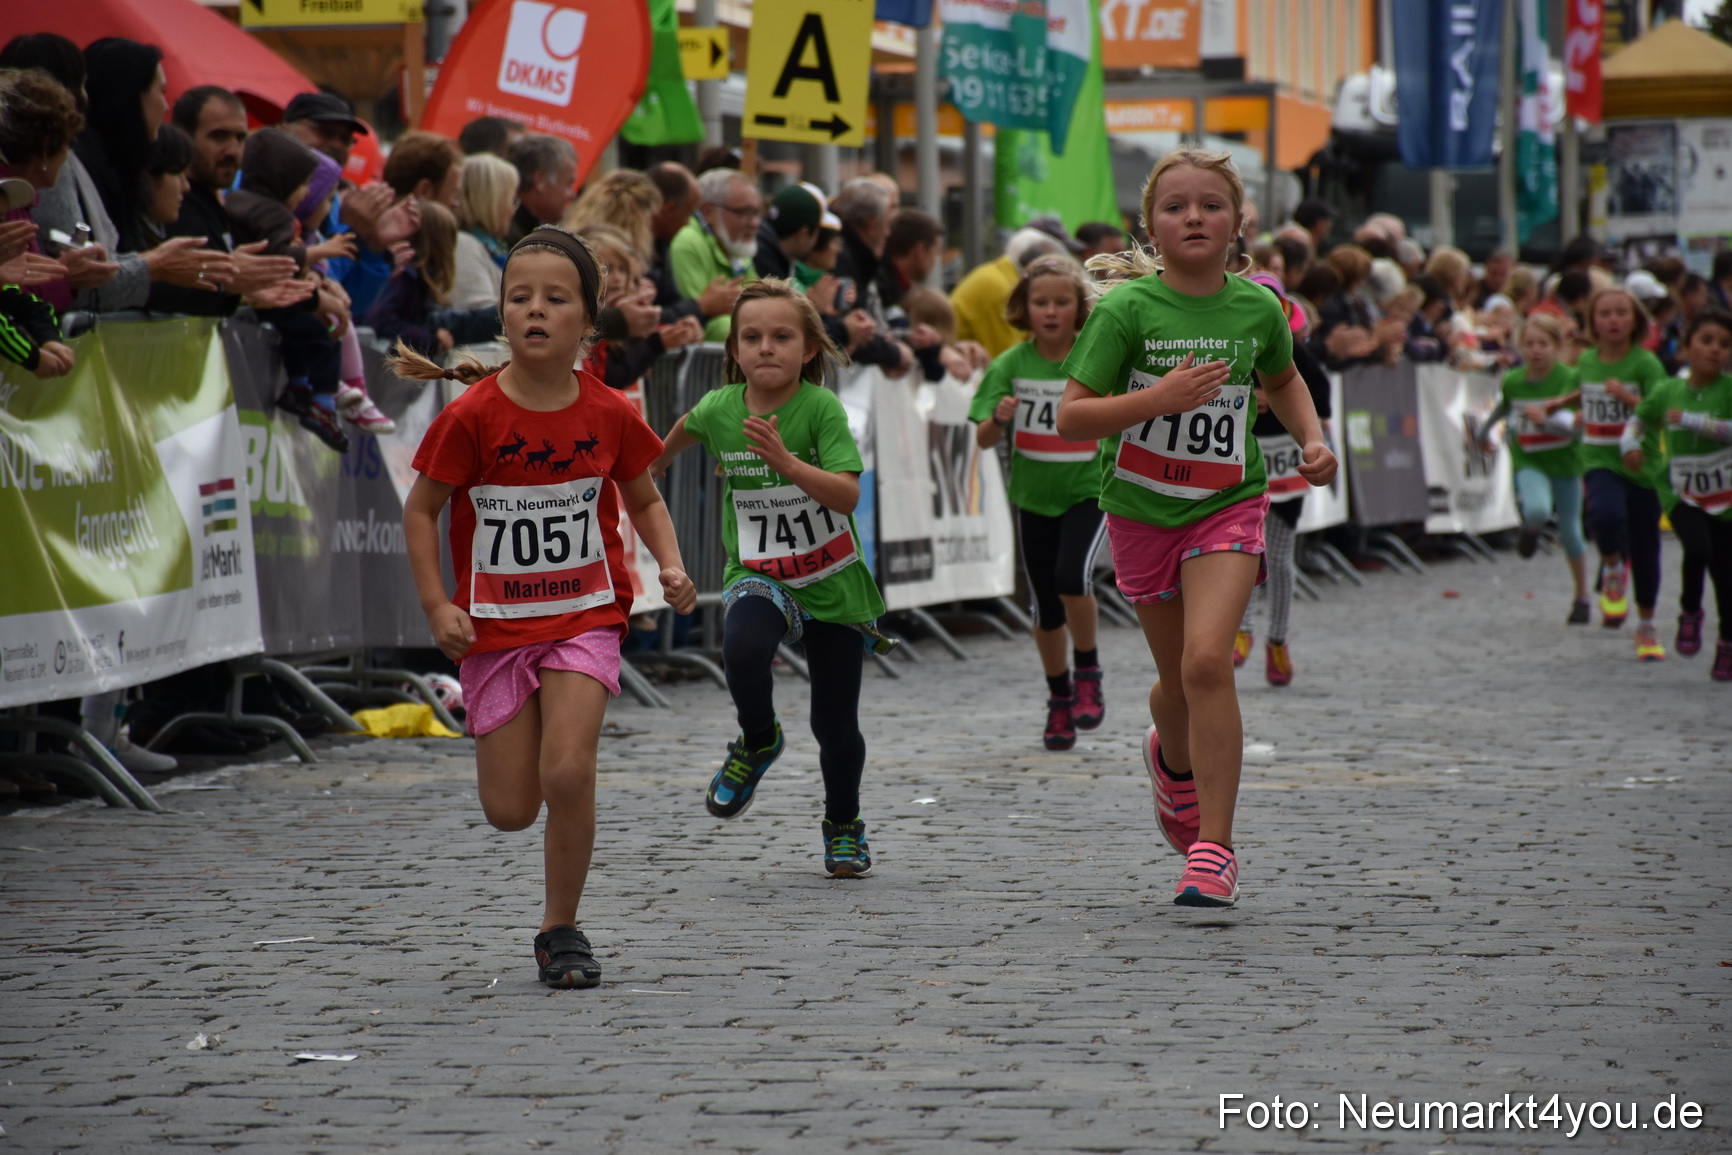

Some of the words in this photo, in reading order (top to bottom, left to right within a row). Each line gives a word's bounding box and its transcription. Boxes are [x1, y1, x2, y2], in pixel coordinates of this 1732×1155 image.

[772, 13, 841, 104] A
[505, 58, 568, 96] DKMS
[1144, 336, 1230, 352] Neumarkter
[1162, 463, 1192, 483] Lili
[476, 497, 514, 512] PARTL
[516, 493, 581, 512] Neumarkt
[736, 500, 769, 511] PARTL
[483, 508, 590, 567] 7057
[748, 505, 836, 554] 7411
[503, 578, 582, 600] Marlene
